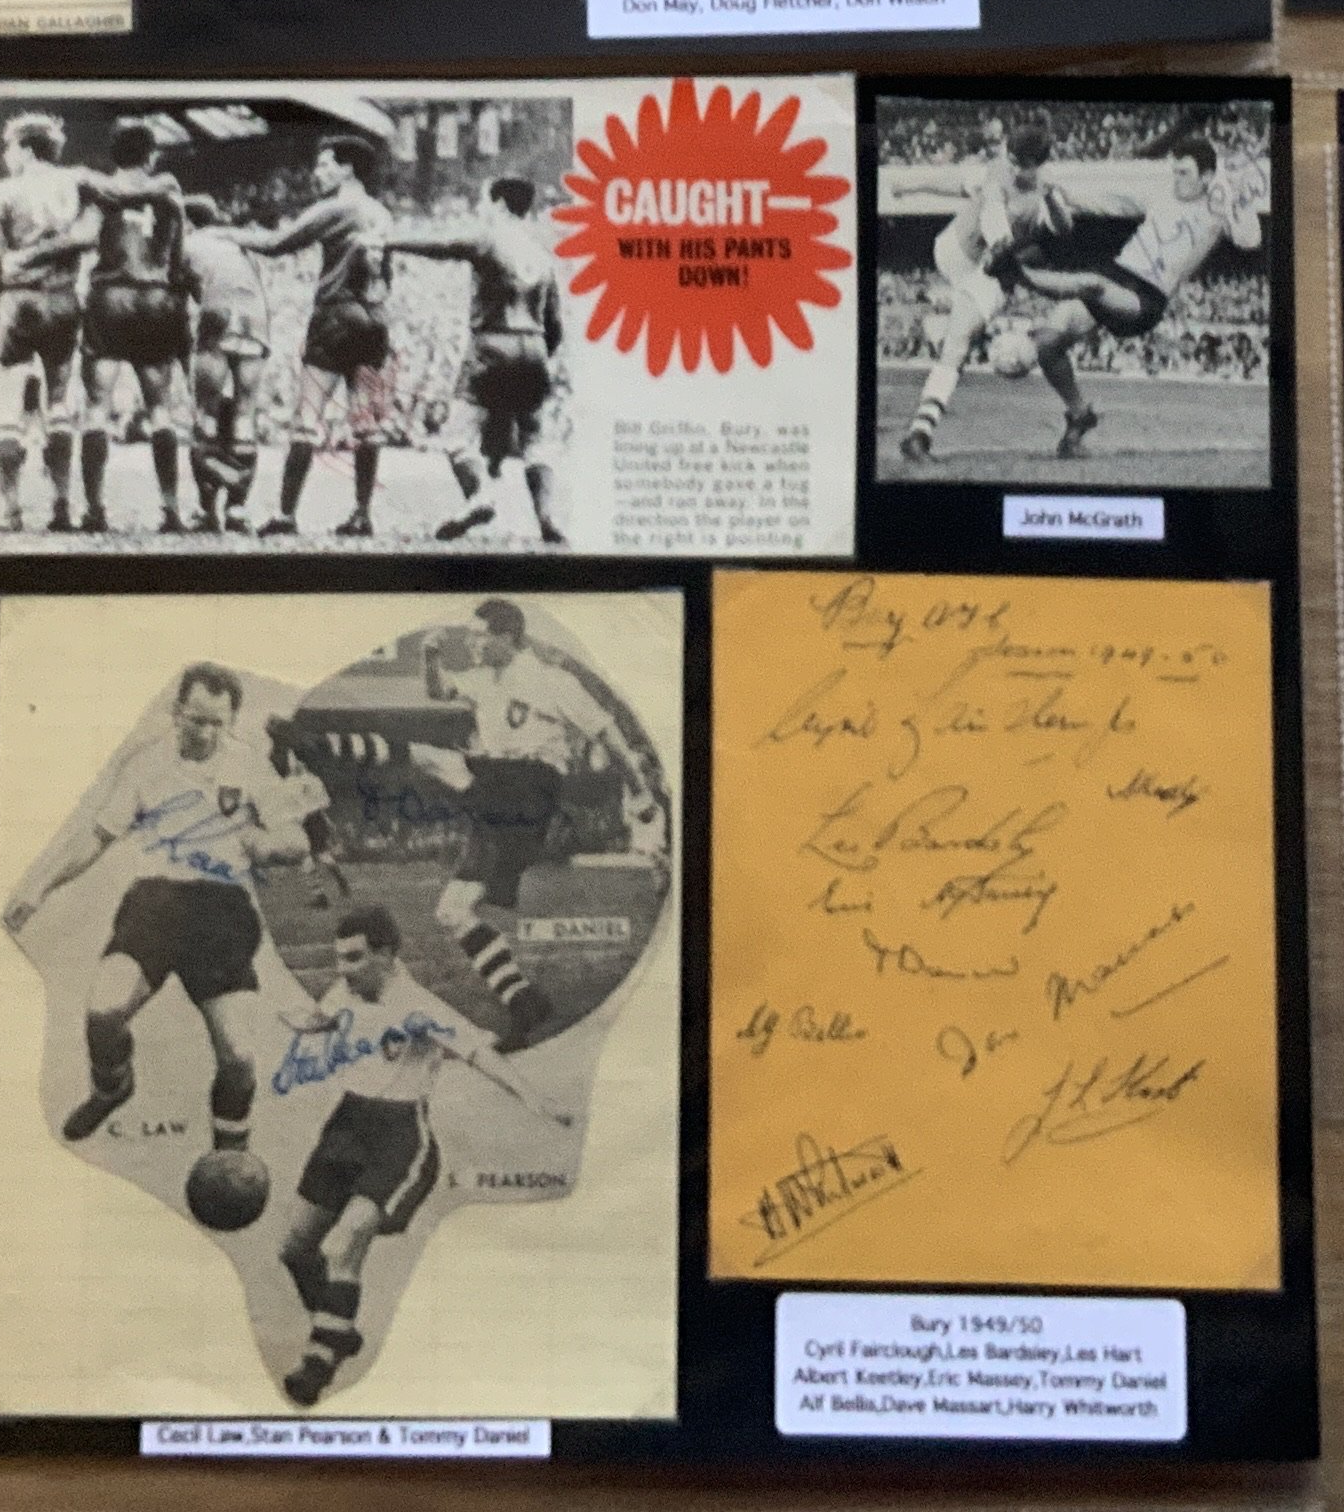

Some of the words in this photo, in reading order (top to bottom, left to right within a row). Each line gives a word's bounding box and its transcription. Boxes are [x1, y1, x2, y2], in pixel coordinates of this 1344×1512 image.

[618, 237, 673, 260] WITH
[678, 237, 718, 260] HIS
[723, 237, 793, 260] PANTS
[677, 263, 750, 289] DOWN!
[613, 477, 705, 493] somebody
[712, 479, 755, 494] gave
[1020, 507, 1063, 526] John
[1067, 508, 1144, 529] McGrath
[553, 920, 628, 939] DANIEL
[141, 1119, 189, 1137] LAW
[477, 1170, 568, 1189] PEARSON
[909, 1315, 951, 1336] Bury
[958, 1315, 1044, 1334] 1949/50
[804, 1339, 845, 1359] Cyril
[1102, 1345, 1144, 1363] Hart
[793, 1367, 849, 1386] Albert
[1111, 1371, 1168, 1390] Daniel
[799, 1394, 826, 1413] Alf
[1064, 1398, 1159, 1418] Whitworth
[156, 1425, 201, 1444] Cecil
[298, 1426, 373, 1445] Pearson
[377, 1425, 392, 1445] &
[397, 1426, 467, 1449] Tommy
[472, 1425, 530, 1445] Daniel
